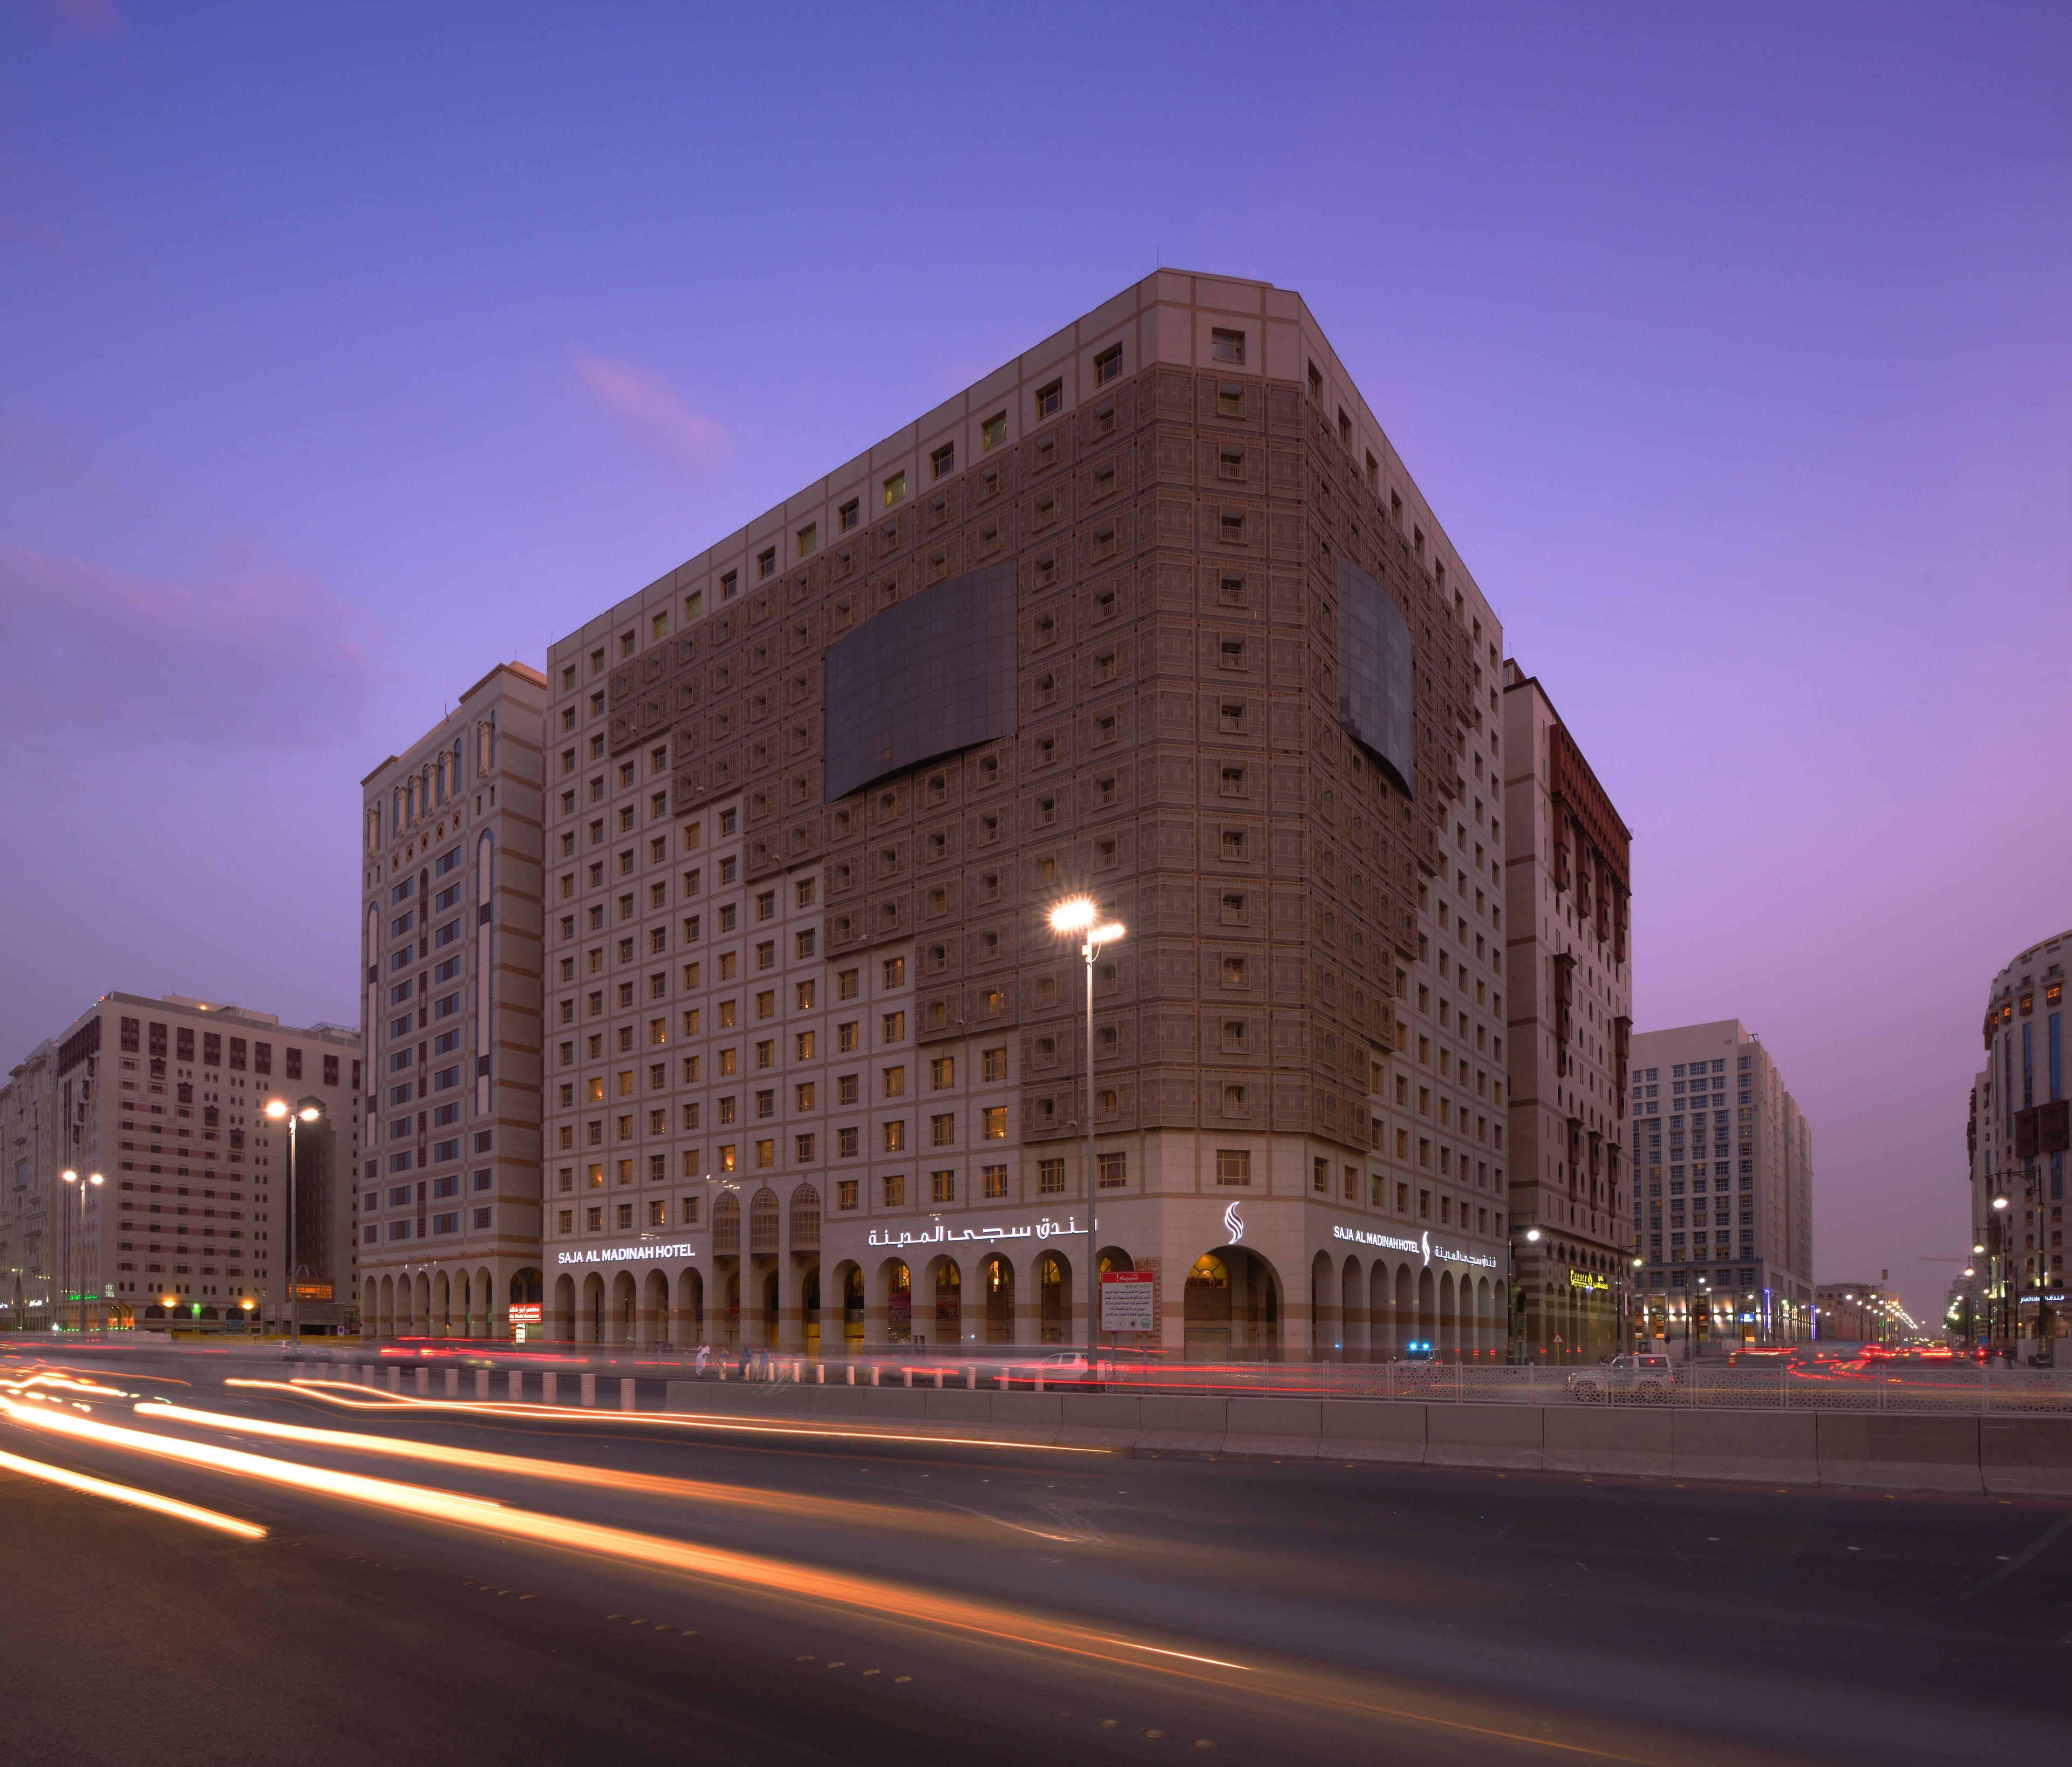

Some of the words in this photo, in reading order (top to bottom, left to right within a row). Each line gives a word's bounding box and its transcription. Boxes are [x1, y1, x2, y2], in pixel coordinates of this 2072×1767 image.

[947, 1226, 1031, 1243] سجى
[1035, 1216, 1097, 1239] ندق
[868, 1225, 944, 1248] المدينة
[1334, 1225, 1354, 1241] SAJA
[1355, 1230, 1366, 1244] AL
[1366, 1232, 1399, 1250] MADINAH
[1399, 1239, 1420, 1253] HOTEL
[558, 1251, 584, 1264] SAJA
[585, 1250, 601, 1263] AL
[602, 1246, 654, 1261] MADINAH
[655, 1244, 696, 1258] HOTEL
[1435, 1245, 1460, 1261] المدينة
[1460, 1253, 1482, 1266] سجى
[1482, 1254, 1496, 1267] فندق
[1116, 1274, 1139, 1282] تنبيه!
[526, 1306, 540, 1314] مطعم
